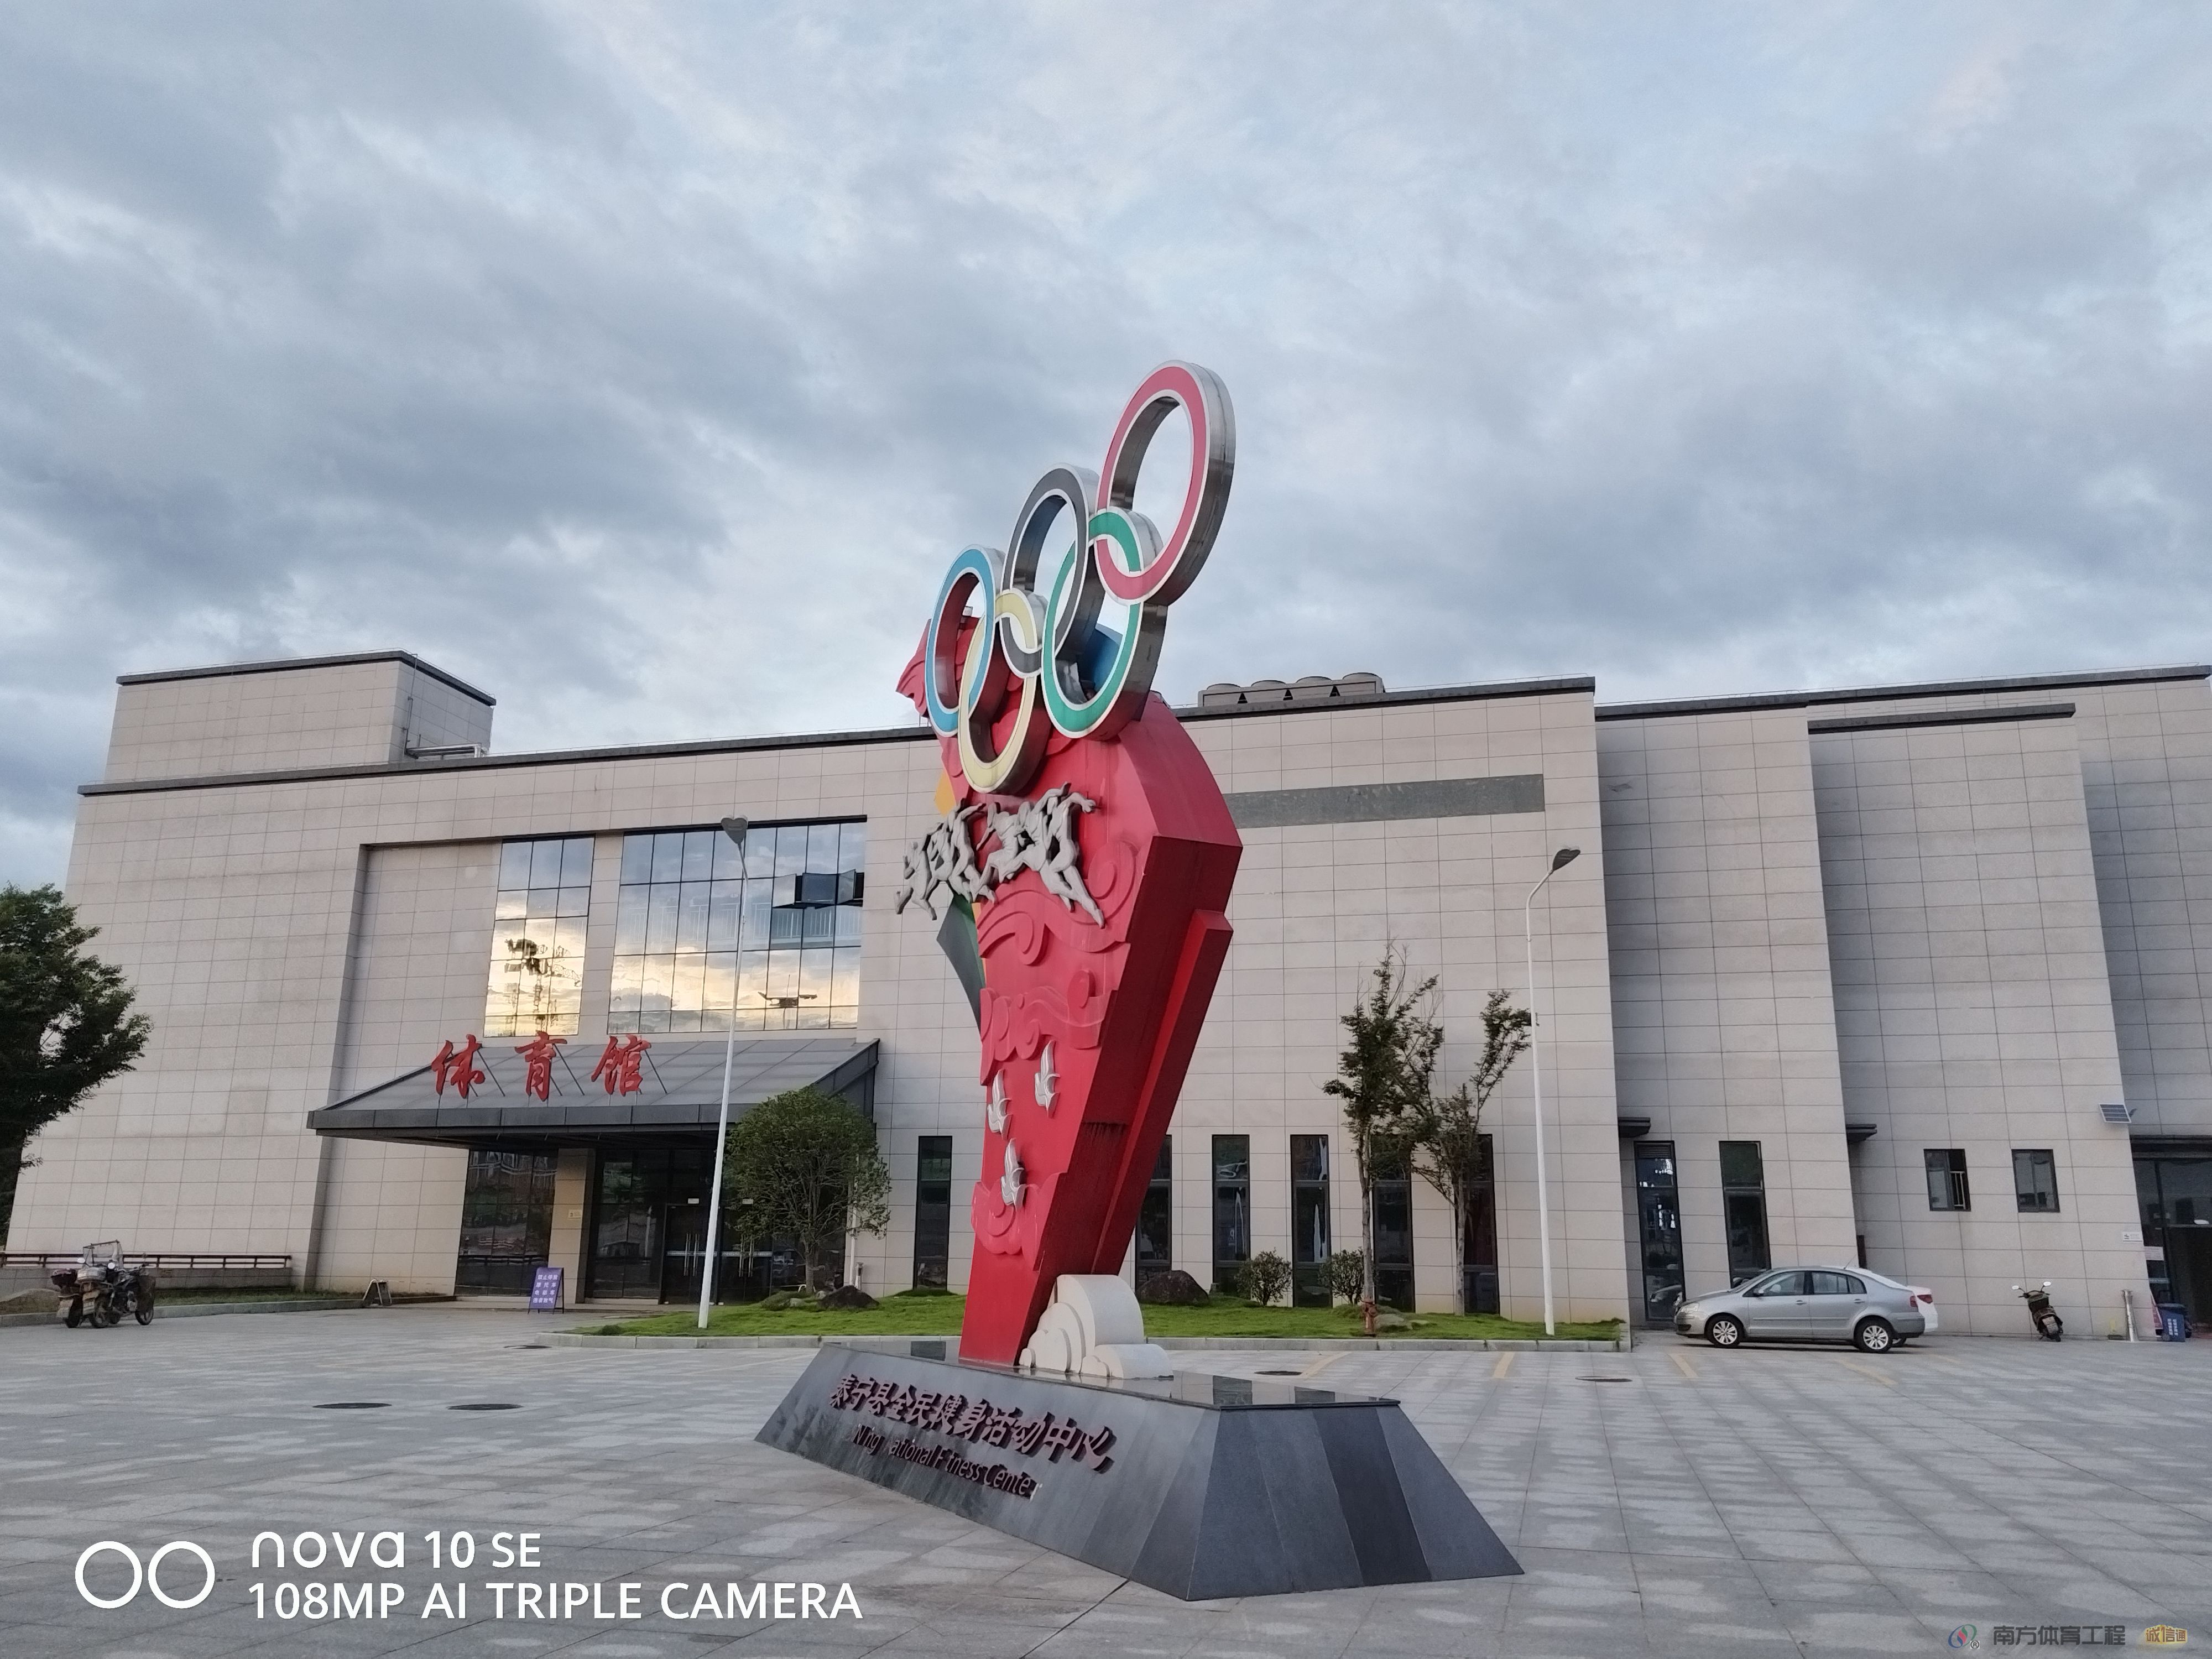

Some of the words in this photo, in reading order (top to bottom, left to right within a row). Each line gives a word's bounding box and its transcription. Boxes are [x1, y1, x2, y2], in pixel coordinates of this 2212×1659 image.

[431, 1031, 651, 1102] 体育馆
[830, 1374, 1112, 1470] 泰宁县全民健身活动中心
[852, 1423, 882, 1455] Nng
[886, 1437, 939, 1466] ational
[933, 1448, 984, 1481] Ftness
[983, 1463, 1043, 1503] Center
